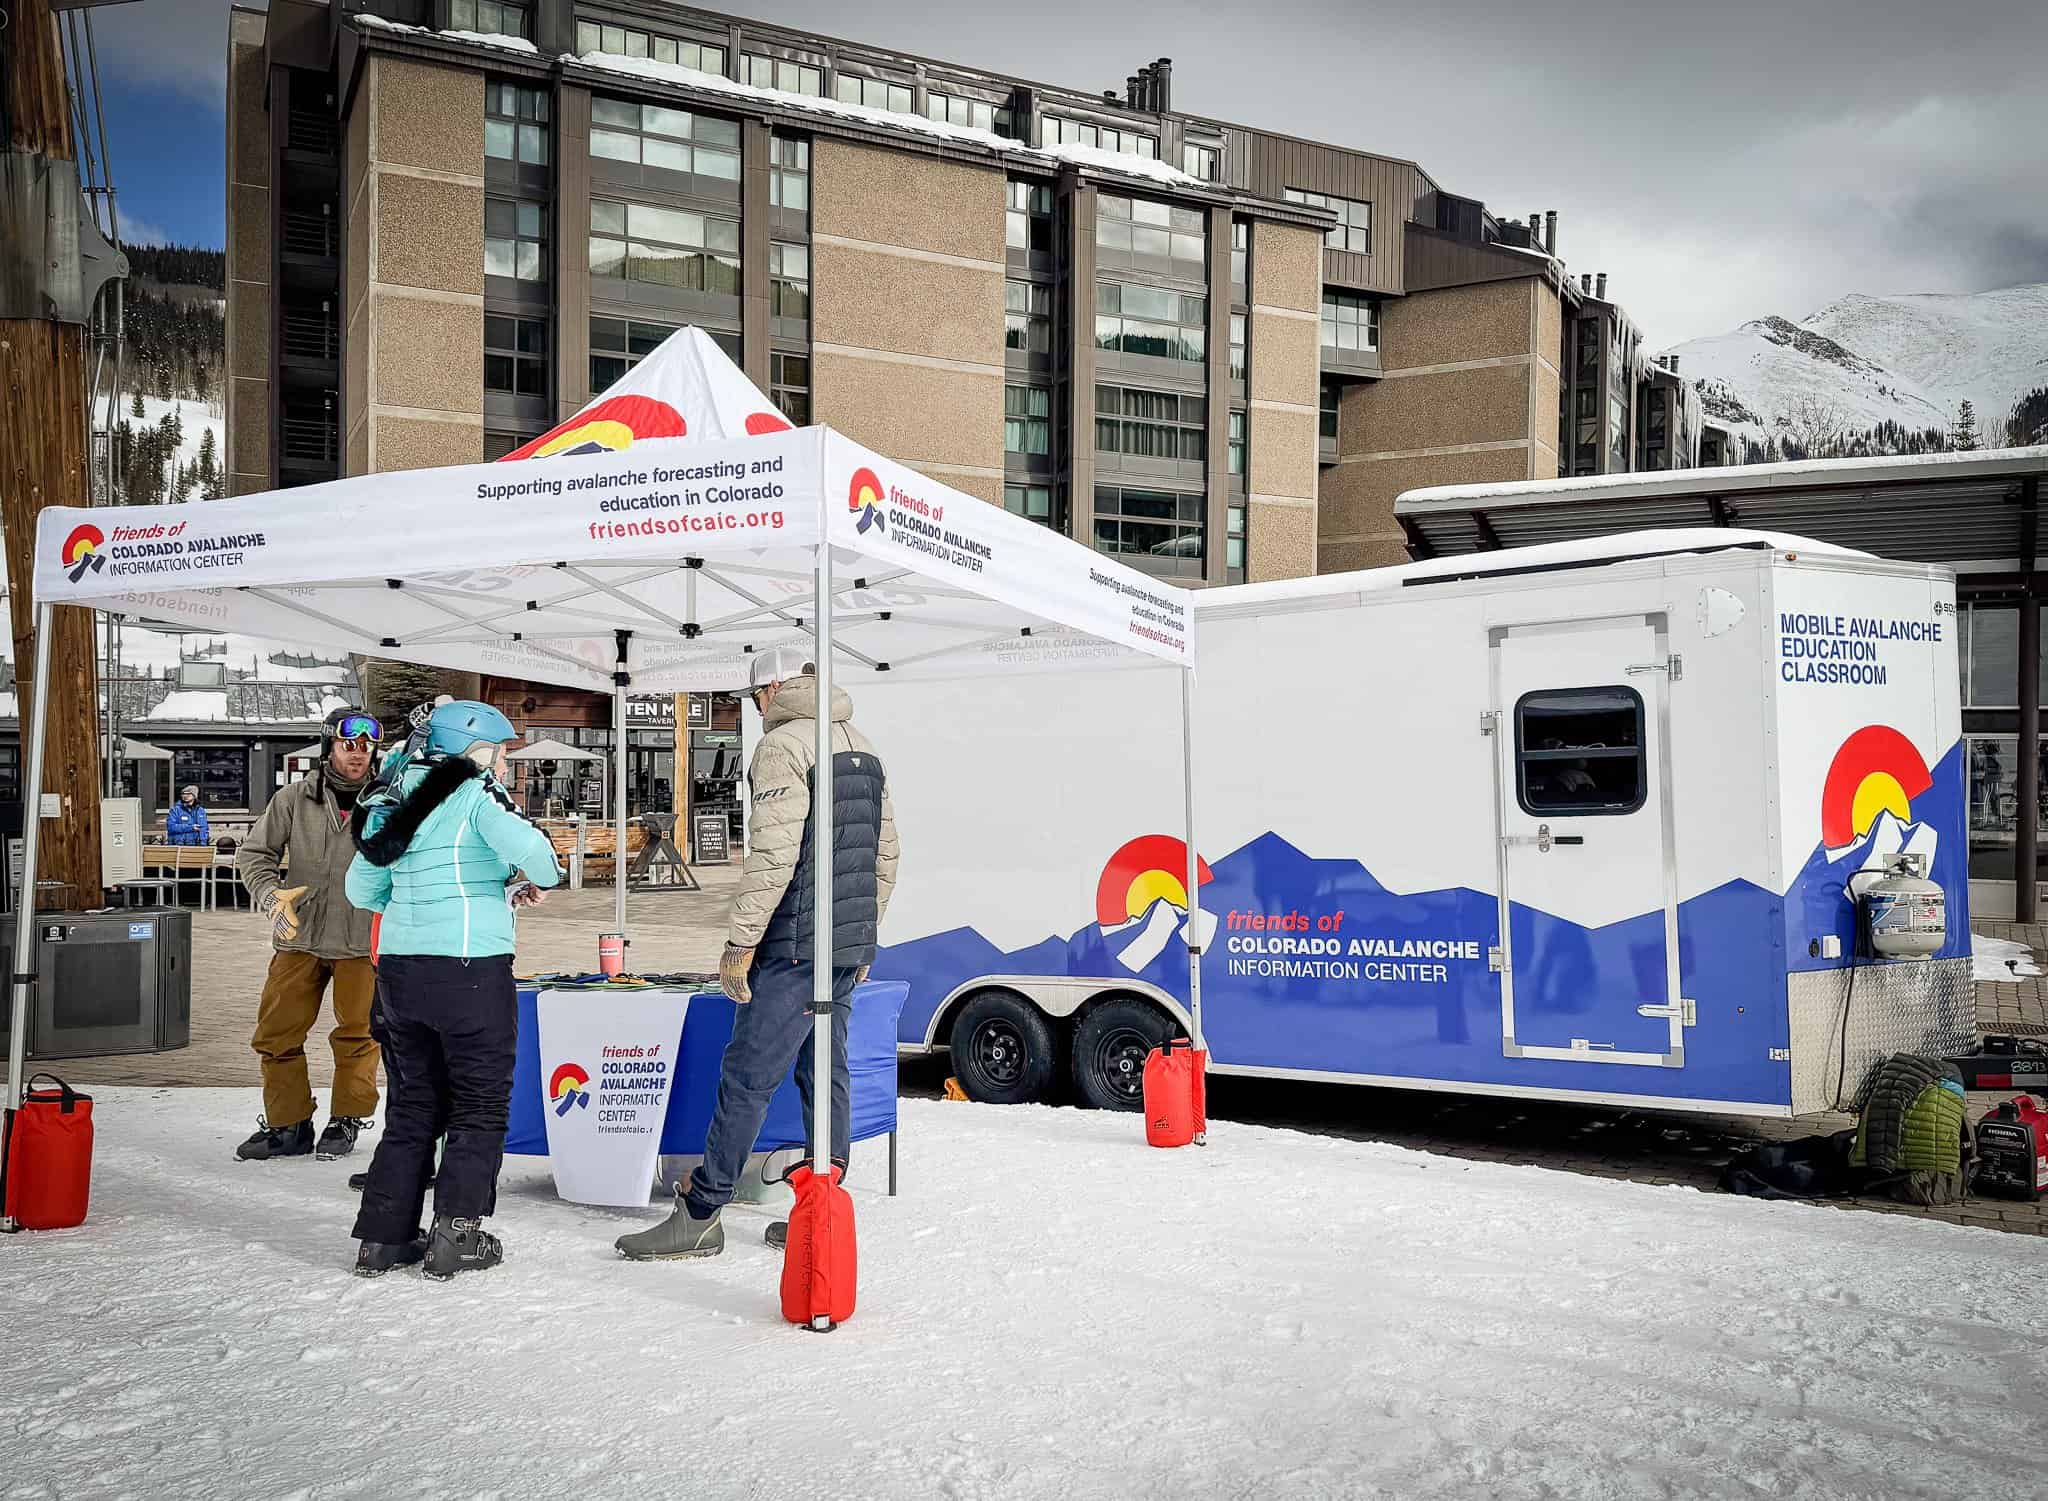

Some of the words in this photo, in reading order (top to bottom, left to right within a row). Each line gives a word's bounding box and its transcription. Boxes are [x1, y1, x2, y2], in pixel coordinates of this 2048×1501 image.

[477, 477, 562, 500] Supporting
[567, 470, 648, 491] avalanche
[652, 460, 746, 483] forecasting
[751, 455, 783, 474] and
[600, 490, 681, 512] education
[685, 488, 701, 506] in
[705, 481, 784, 503] Colorado
[889, 484, 930, 517] friends
[932, 506, 944, 522] of
[111, 523, 166, 542] friends
[168, 520, 187, 537] of
[588, 511, 785, 540] friendsofcaic.org
[889, 508, 941, 541] COLORADO
[943, 530, 992, 560] AVALANCHE
[111, 541, 184, 560] COLORADO
[187, 533, 266, 553] AVALANCHE
[891, 527, 951, 561] INFORMATION
[951, 550, 983, 574] CENTER
[109, 557, 192, 577] INFORMATION
[193, 552, 244, 569] CENTER
[1089, 567, 1121, 594] Supporting
[1174, 604, 1184, 616] and
[1131, 604, 1157, 621] education
[1157, 613, 1163, 625] in
[1162, 614, 1185, 633] Colorado
[1780, 613, 1846, 637] MOBILE
[1849, 617, 1943, 642] AVALANCHE
[1129, 620, 1185, 653] friendsofcaic.org
[1781, 637, 1877, 661] EDUCATION
[1781, 661, 1887, 685] CLASSROOM
[625, 702, 658, 716] TEN
[662, 703, 702, 717] ME
[1226, 910, 1310, 932] friends
[1317, 910, 1345, 932] of
[1227, 936, 1342, 956] COLORADO
[1347, 940, 1481, 960] AVALANCHE
[1228, 959, 1359, 980] INFORMATION
[1364, 963, 1448, 983] CENTER
[602, 1044, 645, 1058] friends
[647, 1043, 661, 1058] of
[601, 1061, 667, 1074] COLORADO
[599, 1077, 667, 1090] AVALANCHE
[598, 1110, 637, 1122] CENTER
